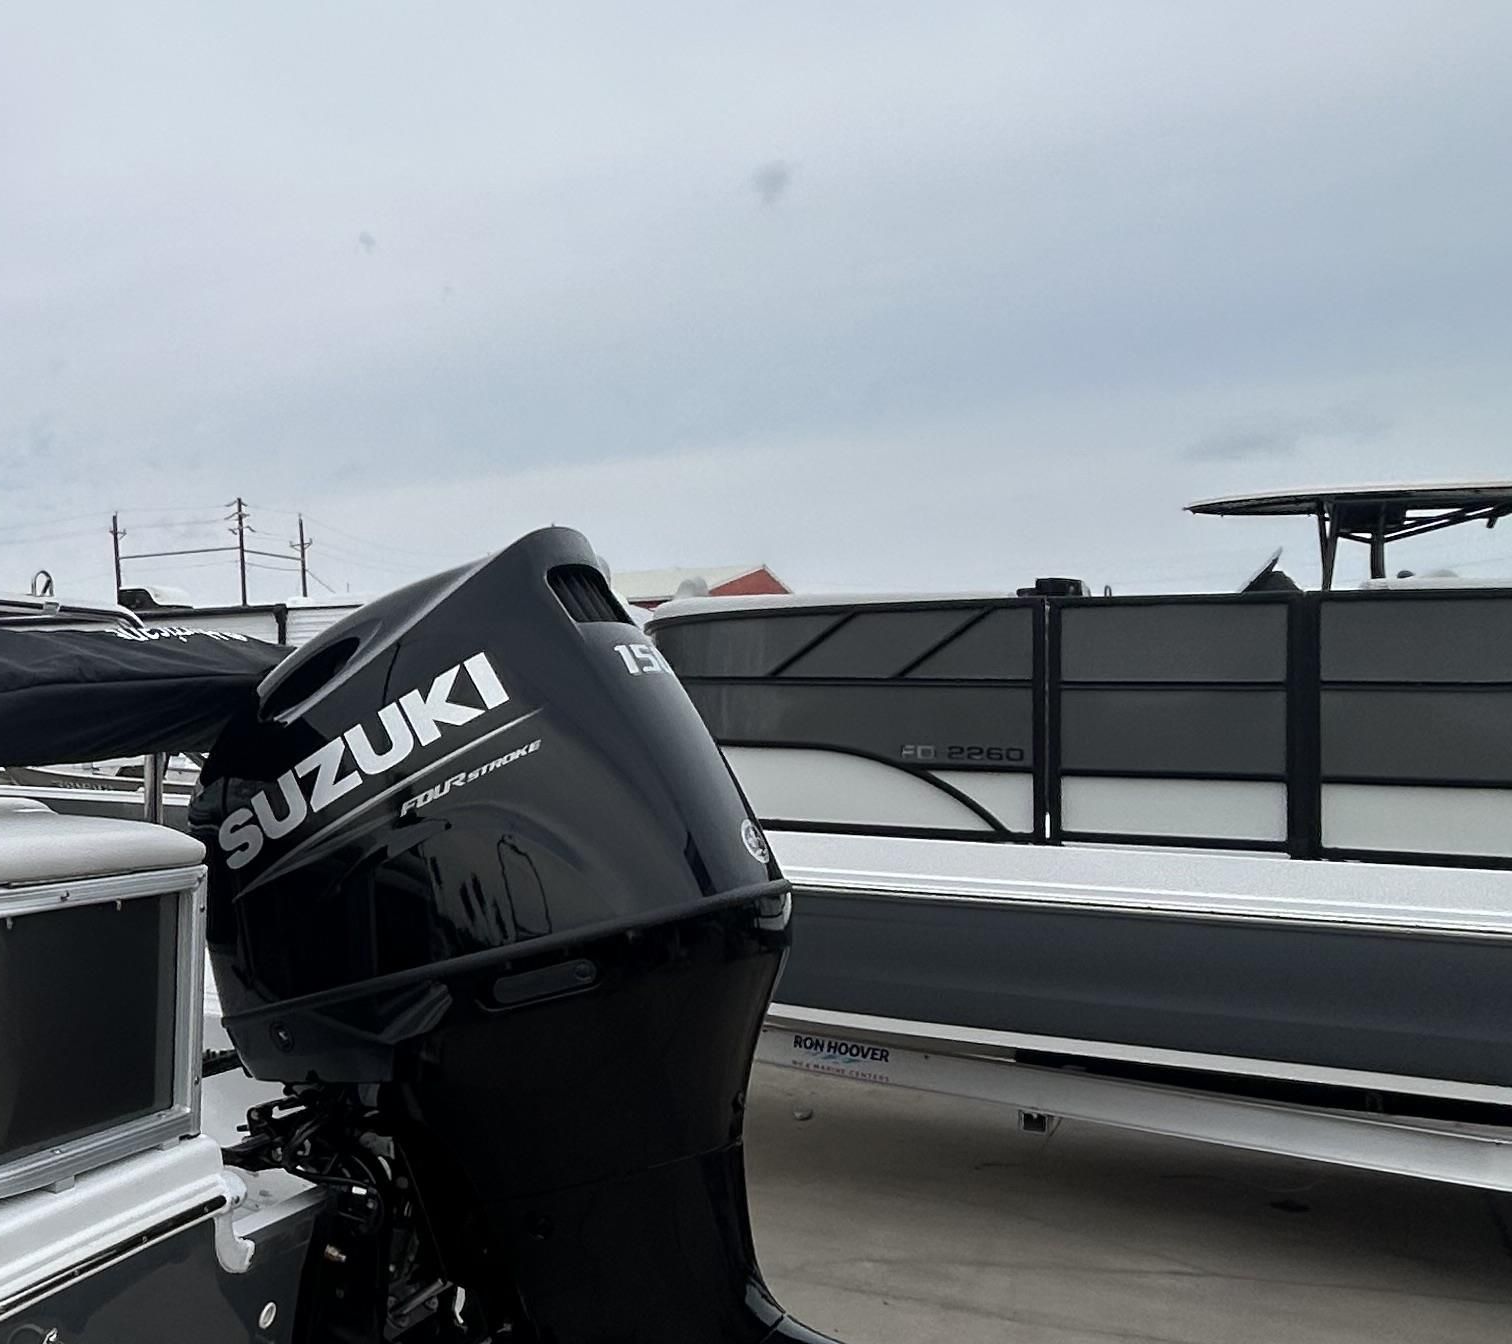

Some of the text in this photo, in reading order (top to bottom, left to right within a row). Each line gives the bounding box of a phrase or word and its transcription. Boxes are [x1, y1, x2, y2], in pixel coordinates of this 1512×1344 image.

[219, 652, 510, 869] SUZUKI
[400, 739, 542, 817] FOUR STROKE
[947, 746, 1024, 762] 2260
[793, 1035, 890, 1062] RON HOOVER
